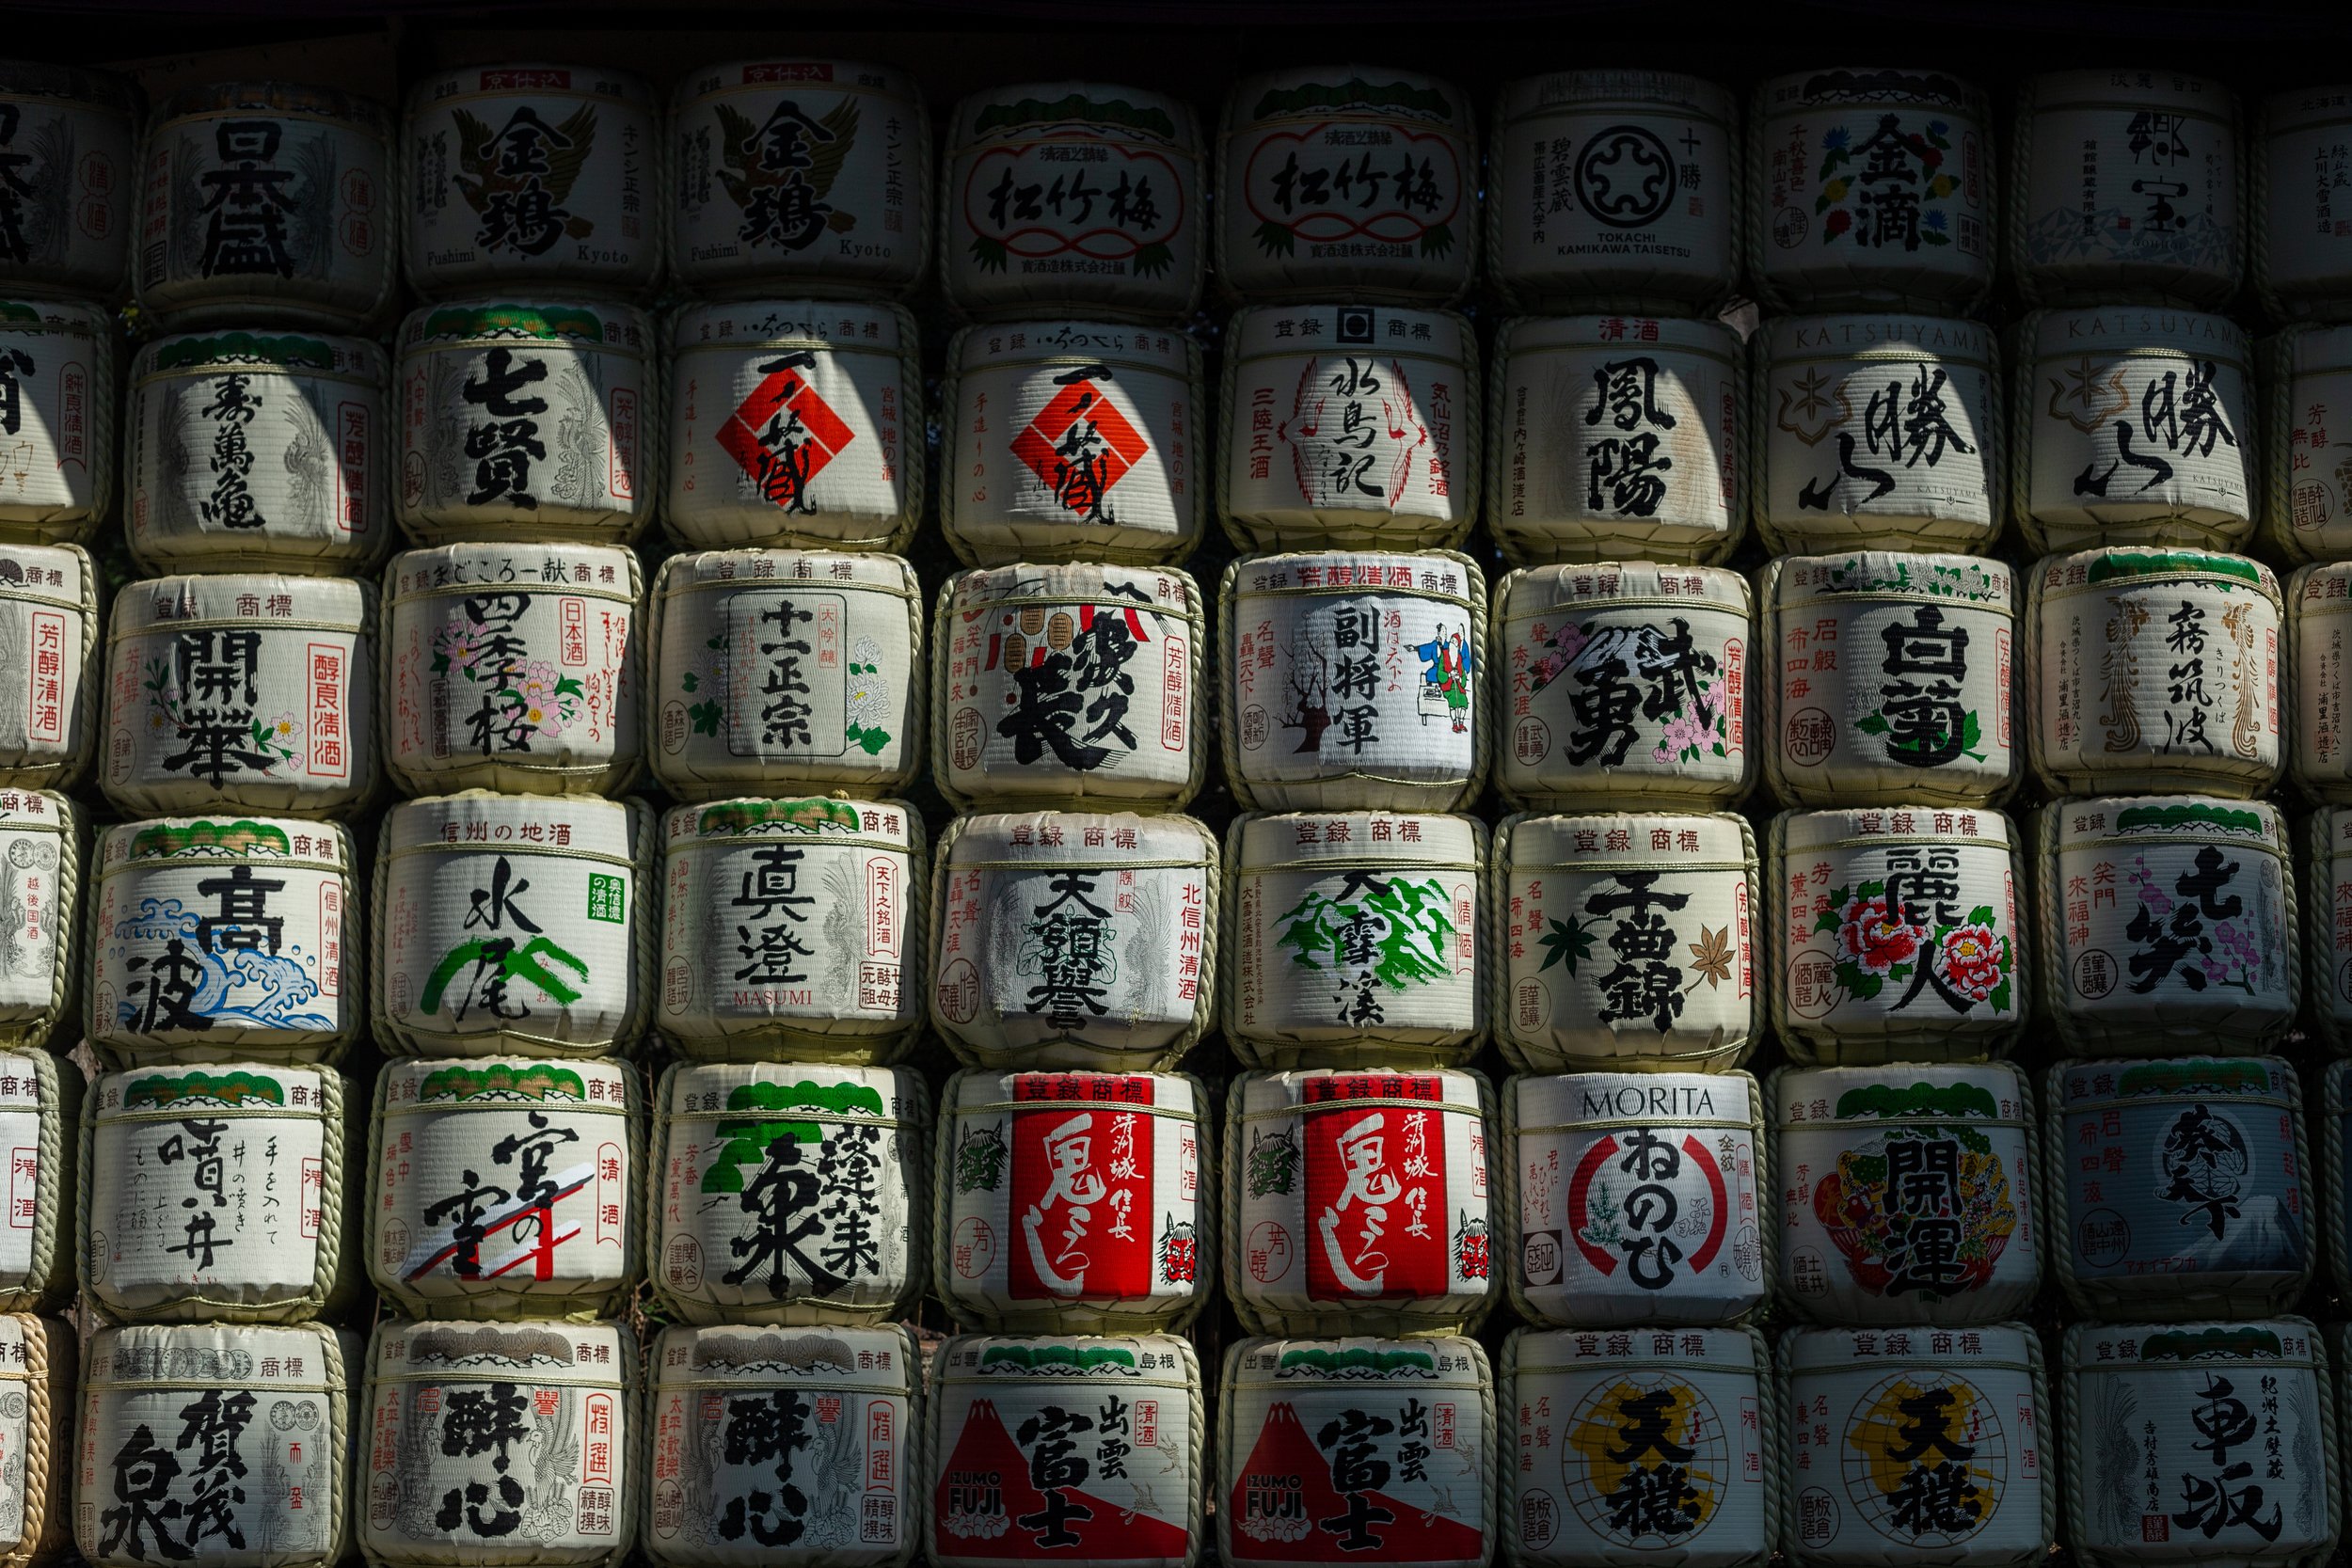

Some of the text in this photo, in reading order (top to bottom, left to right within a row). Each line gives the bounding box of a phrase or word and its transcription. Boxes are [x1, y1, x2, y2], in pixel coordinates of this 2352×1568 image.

[484, 71, 564, 91] 京仕込
[747, 65, 824, 83] 京仕込
[622, 123, 641, 213] キンシ正宗
[884, 117, 903, 205] キンシ正宗
[1270, 150, 1443, 215] 松竹梅
[1547, 137, 1574, 215] 碧雲蔵
[1678, 127, 1702, 190] 十勝
[1850, 113, 1935, 252] 金滴
[2315, 147, 2332, 234] 上川大雪酒造
[988, 166, 1162, 232] 松竹梅
[427, 245, 629, 266] Fushimi Kyoto
[691, 239, 892, 261] Fushimi Kyoto
[1558, 245, 1692, 259] KAMIKAWA TAISETSU
[1597, 232, 1656, 244] TOKACHI
[1135, 334, 1172, 356] 商標
[1274, 318, 1433, 341] 登録 商標
[1597, 316, 1660, 343] 清酒
[1796, 323, 1981, 354] KATSUYAMA
[2069, 314, 2243, 347] KATSUYAMA
[462, 346, 548, 509] 七賢
[613, 397, 635, 491] 芳醇清酒
[683, 378, 698, 492] 手造りの心
[881, 387, 898, 482] 宮城地の酒
[972, 391, 989, 503] 手造りの心
[1171, 400, 1184, 496] 宮城地の酒
[1249, 387, 1278, 481] 三陸王酒
[1329, 356, 1386, 499] 水鳥記
[1428, 381, 1452, 498] 気仙沼乃銘酒
[1585, 356, 1677, 518] 鳳陽
[2307, 404, 2329, 449] 芳醇
[1421, 571, 1458, 594] 商標
[2046, 564, 2087, 589] 登録
[564, 602, 583, 661] 日本酒
[965, 625, 982, 676] 笑門
[36, 624, 61, 732] 芳醇清酒
[465, 591, 539, 754] 四季桜
[758, 599, 814, 749] 十一正宗
[1167, 645, 1184, 743] 芳醇清酒
[1331, 604, 1381, 754] 副将軍
[1563, 616, 1717, 768] 武勇
[1881, 604, 1970, 768] 白菊
[2165, 599, 2214, 754] 霧筑波
[2215, 646, 2227, 724] きりつくば
[440, 820, 572, 847] 信州の地酒
[1009, 825, 1138, 849] 登録 商標
[1294, 818, 1423, 846] 登録 商標
[1573, 828, 1700, 853] 登録 商標
[1857, 812, 1979, 836] 登録 商標
[876, 865, 892, 944] 天下之銘酒
[2091, 861, 2118, 911] 笑門
[323, 889, 340, 988] 信州清酒
[456, 855, 544, 1022] 水尾
[1178, 882, 1202, 1001] 北信州清酒
[1456, 899, 1473, 959] 清酒
[1885, 847, 1979, 1016] 麗人
[2125, 846, 2244, 994] 七笑
[734, 989, 813, 1007] MASUMI
[1582, 1086, 1716, 1118] MORITA
[600, 1157, 621, 1226] 清酒
[682, 1144, 699, 1186] 芳香
[1738, 1157, 1754, 1212] 清酒
[1619, 1128, 1684, 1291] ねのひ
[1883, 1139, 1976, 1297] 開運
[2122, 1256, 2198, 1275] アオイテンカ
[950, 1350, 1177, 1370] 出雲 島根
[1244, 1354, 1470, 1372] 出雲 島根
[1575, 1334, 1706, 1358] 登録 商標
[1852, 1333, 1983, 1357] 登録 商標
[588, 1402, 610, 1476] 特選
[871, 1410, 891, 1483] 特選
[1096, 1394, 1131, 1481] 出雲
[1136, 1402, 1156, 1444] 清酒
[1398, 1397, 1430, 1483] 出雲
[1436, 1406, 1454, 1447] 清酒
[1742, 1409, 1759, 1474] 清酒
[2019, 1405, 2037, 1469] 清酒
[948, 1471, 1001, 1487] IZUMO
[1015, 1405, 1094, 1549] 富士
[1246, 1474, 1303, 1490] IZUMO
[1317, 1409, 1395, 1550] 富士
[2142, 1419, 2160, 1513] 吉村秀雄商店
[2172, 1370, 2283, 1543] 車坂
[948, 1487, 1002, 1516] FUJI
[1247, 1490, 1303, 1519] FUJI
